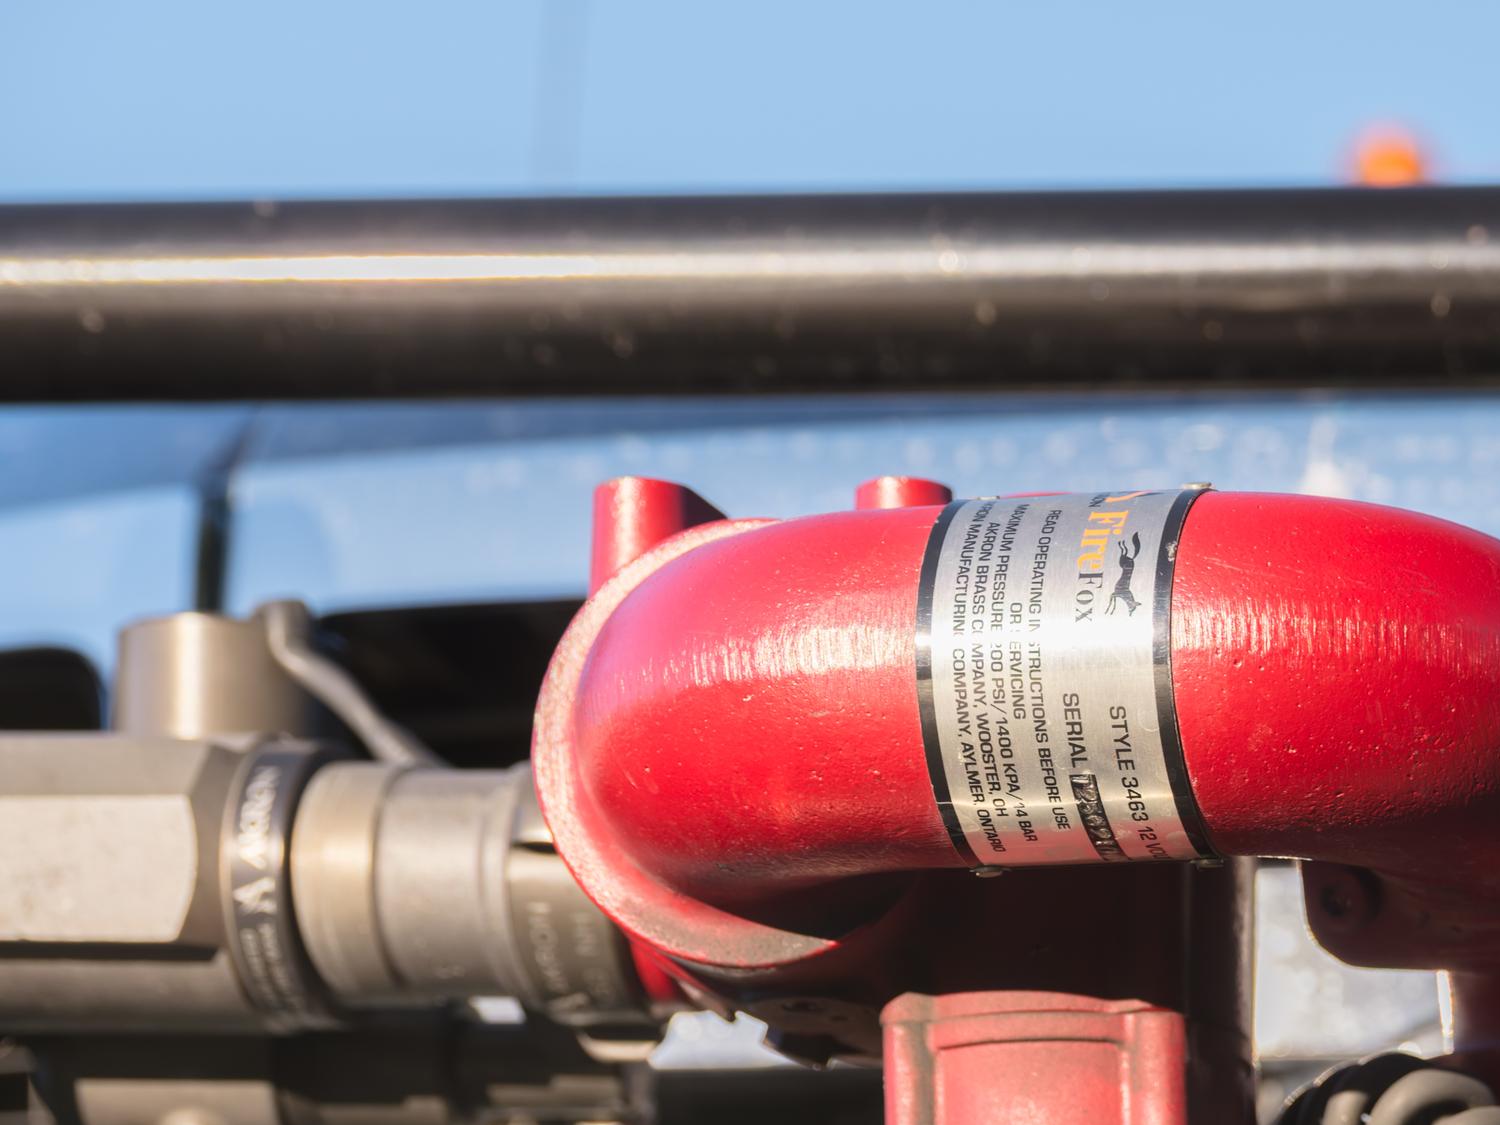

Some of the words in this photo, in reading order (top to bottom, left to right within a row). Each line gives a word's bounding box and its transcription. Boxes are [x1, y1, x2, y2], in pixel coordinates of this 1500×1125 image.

[978, 521, 1001, 562] AKRON
[1000, 503, 1030, 552] MAXIMUM
[1041, 509, 1062, 535] READ
[971, 564, 989, 615] BRASS
[990, 555, 1010, 632] PRESSURE
[1028, 536, 1052, 615] OPERATING
[1009, 602, 1023, 625] OR
[1009, 628, 1027, 720] ERVICING
[952, 648, 973, 737] COMPANY,
[976, 808, 1007, 853] ONTARIO
[975, 712, 1002, 795] WOOSTER,
[1062, 692, 1088, 769] SERIAL
[1109, 705, 1136, 771] STYLE
[1037, 747, 1062, 804] BEFORE
[1121, 776, 1149, 822] 3463
[992, 797, 1010, 817] OH
[1018, 820, 1039, 842] BAR
[1051, 806, 1072, 830] USE
[1136, 826, 1157, 841] 12
